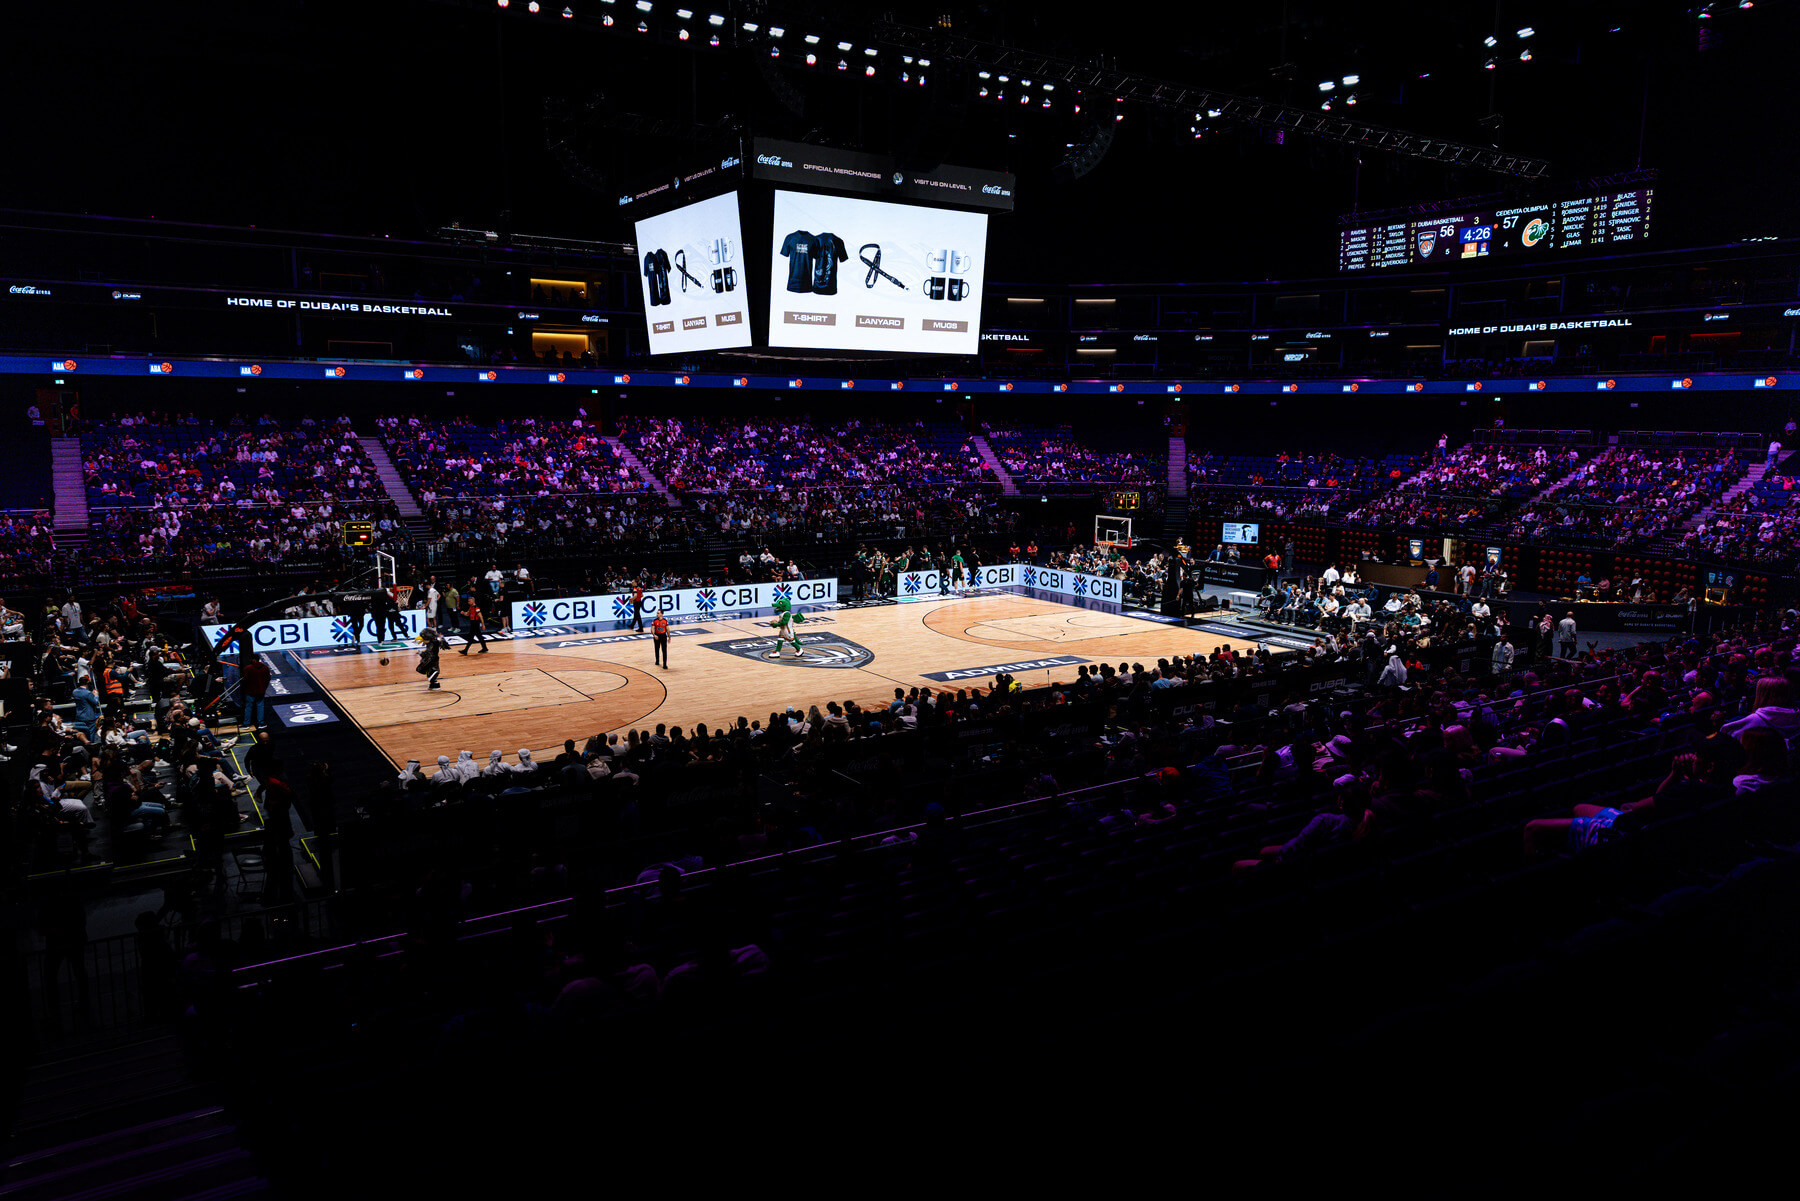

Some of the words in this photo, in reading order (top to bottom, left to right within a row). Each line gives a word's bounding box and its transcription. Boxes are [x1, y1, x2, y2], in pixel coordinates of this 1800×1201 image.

[758, 154, 781, 166] Coca-Cola
[803, 164, 832, 173] OFFICIAL
[834, 168, 882, 180] MERCHANDISE
[982, 184, 1001, 195] Coca-Cola
[1617, 192, 1636, 200] BLAZIC
[1561, 199, 1585, 208] STEWART
[1496, 208, 1522, 217] CEDEVITA
[1523, 204, 1548, 213] OLIMPIJA
[1561, 207, 1589, 215] ROBINSON
[1612, 208, 1639, 217] BERINGER
[1434, 216, 1464, 225] BASKETBALL
[1474, 216, 1479, 224] 3
[1503, 216, 1519, 229] 57
[1608, 216, 1641, 226] STIPANOVIC
[1440, 225, 1454, 237] 56
[1464, 227, 1490, 240] 4:26
[9, 285, 36, 295] Coca-Cola
[227, 298, 273, 307] HOME
[276, 300, 296, 308] OF
[300, 301, 359, 311] DUBAI'S
[363, 305, 452, 316] BASKETBALL
[684, 319, 705, 327] LANYARD
[793, 314, 828, 323] T-SHIRT
[859, 317, 900, 326] LANYARD
[933, 322, 958, 330] MUGS
[1449, 327, 1480, 335] HOME
[1500, 324, 1547, 333] DUBAI'S
[1550, 319, 1632, 330] BASKETBALL
[986, 567, 1014, 584] CBI
[1040, 571, 1063, 589] CBI
[797, 582, 830, 600] CBI
[1090, 579, 1117, 599] CBI
[641, 594, 680, 613] CBI
[722, 588, 758, 606] CBI
[552, 600, 595, 620] CBI
[254, 622, 309, 646] CBI
[558, 630, 698, 648] ADMIRL
[945, 659, 1078, 679] ADMIRAL
